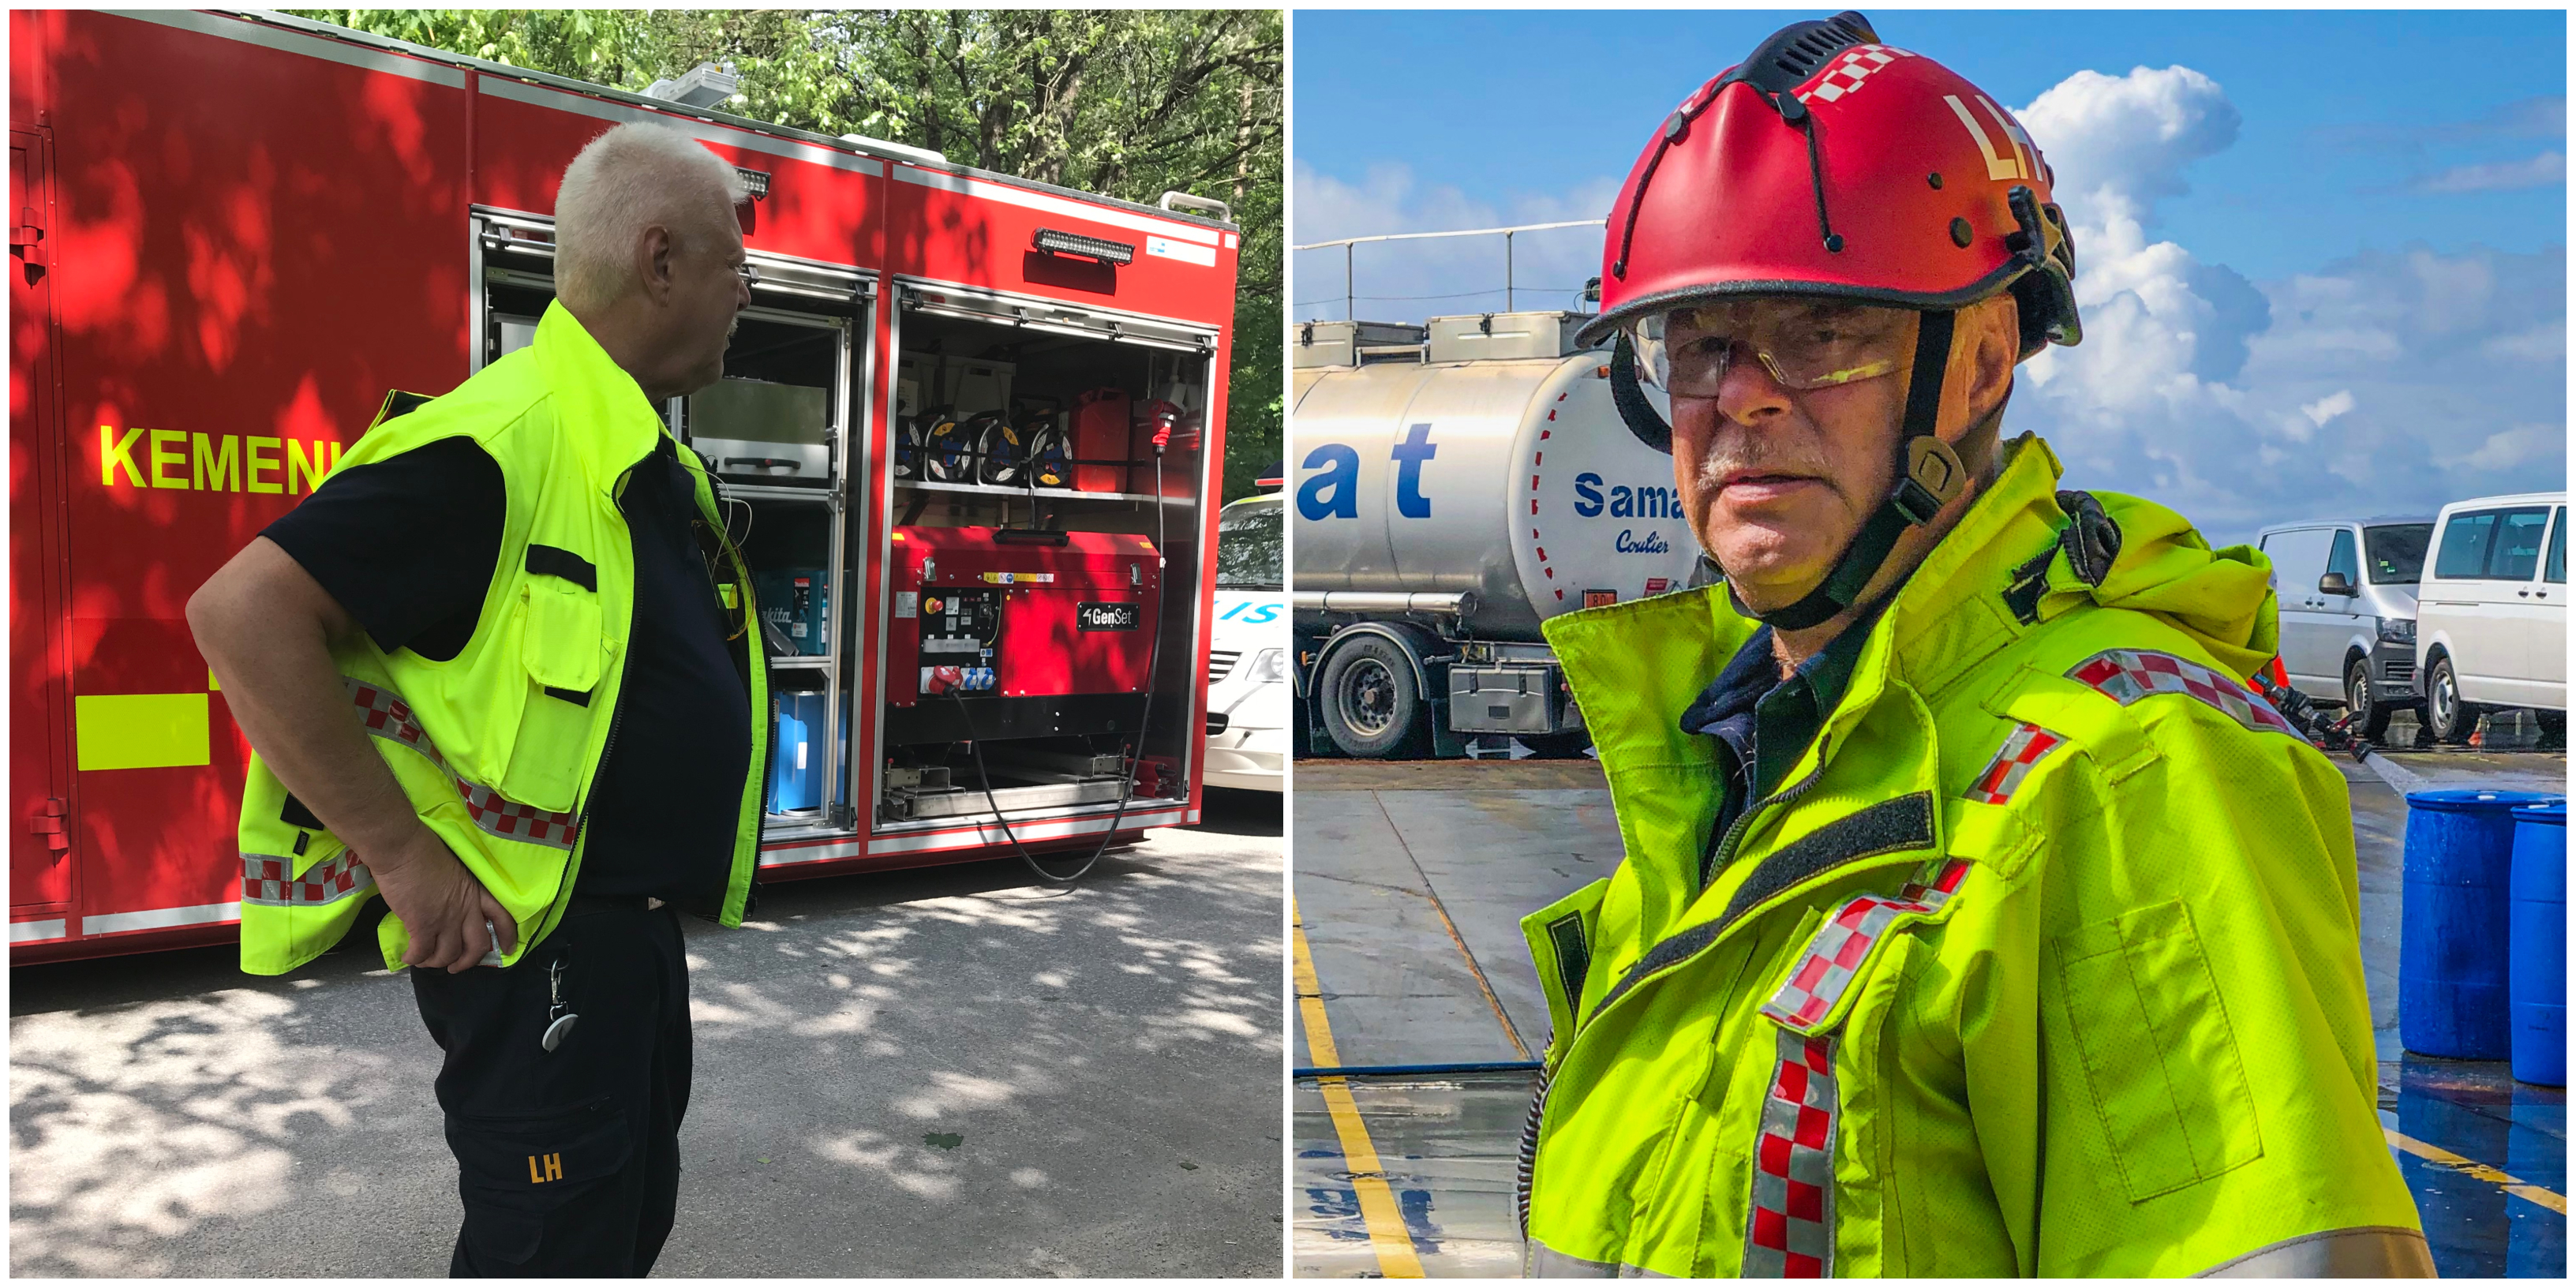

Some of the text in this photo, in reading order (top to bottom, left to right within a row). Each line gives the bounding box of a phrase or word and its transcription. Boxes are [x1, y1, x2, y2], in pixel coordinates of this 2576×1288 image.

[1943, 94, 2043, 182] LH
[1297, 423, 1437, 521] at
[1616, 529, 1669, 553] Coulier
[1092, 608, 1132, 625] GenSet
[1214, 601, 1284, 623] IS
[528, 1152, 563, 1183] LH
